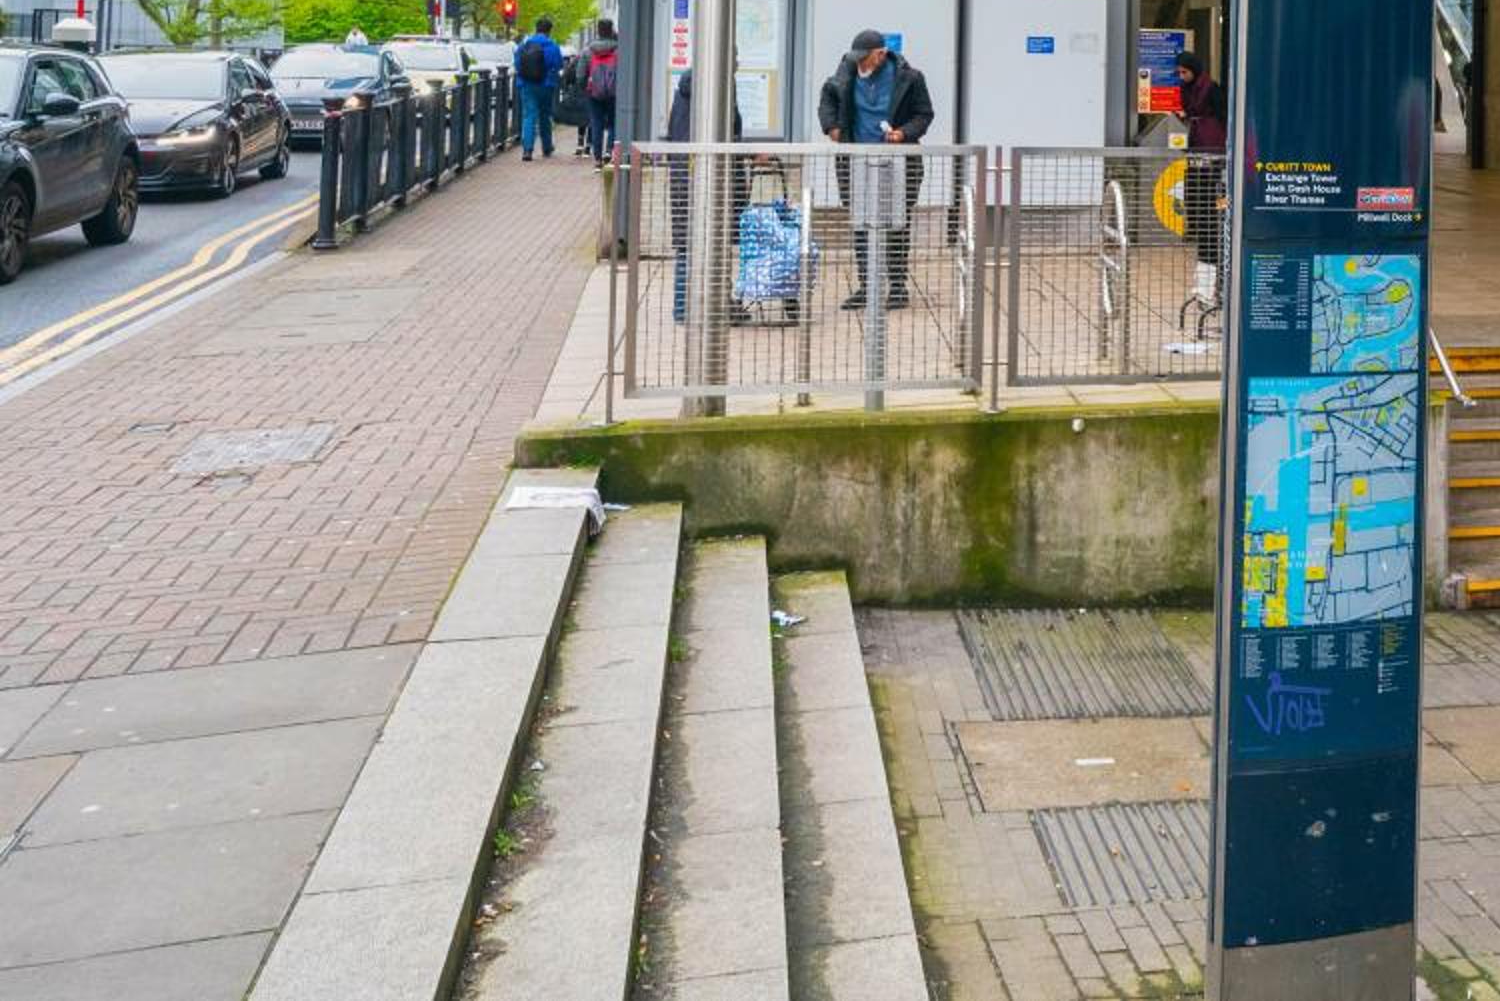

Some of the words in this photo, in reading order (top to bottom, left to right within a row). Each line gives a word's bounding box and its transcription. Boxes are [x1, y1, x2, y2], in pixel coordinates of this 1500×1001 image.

[1302, 163, 1331, 172] TOWN
[1265, 173, 1309, 183] Exchange
[1311, 174, 1338, 183] Tower
